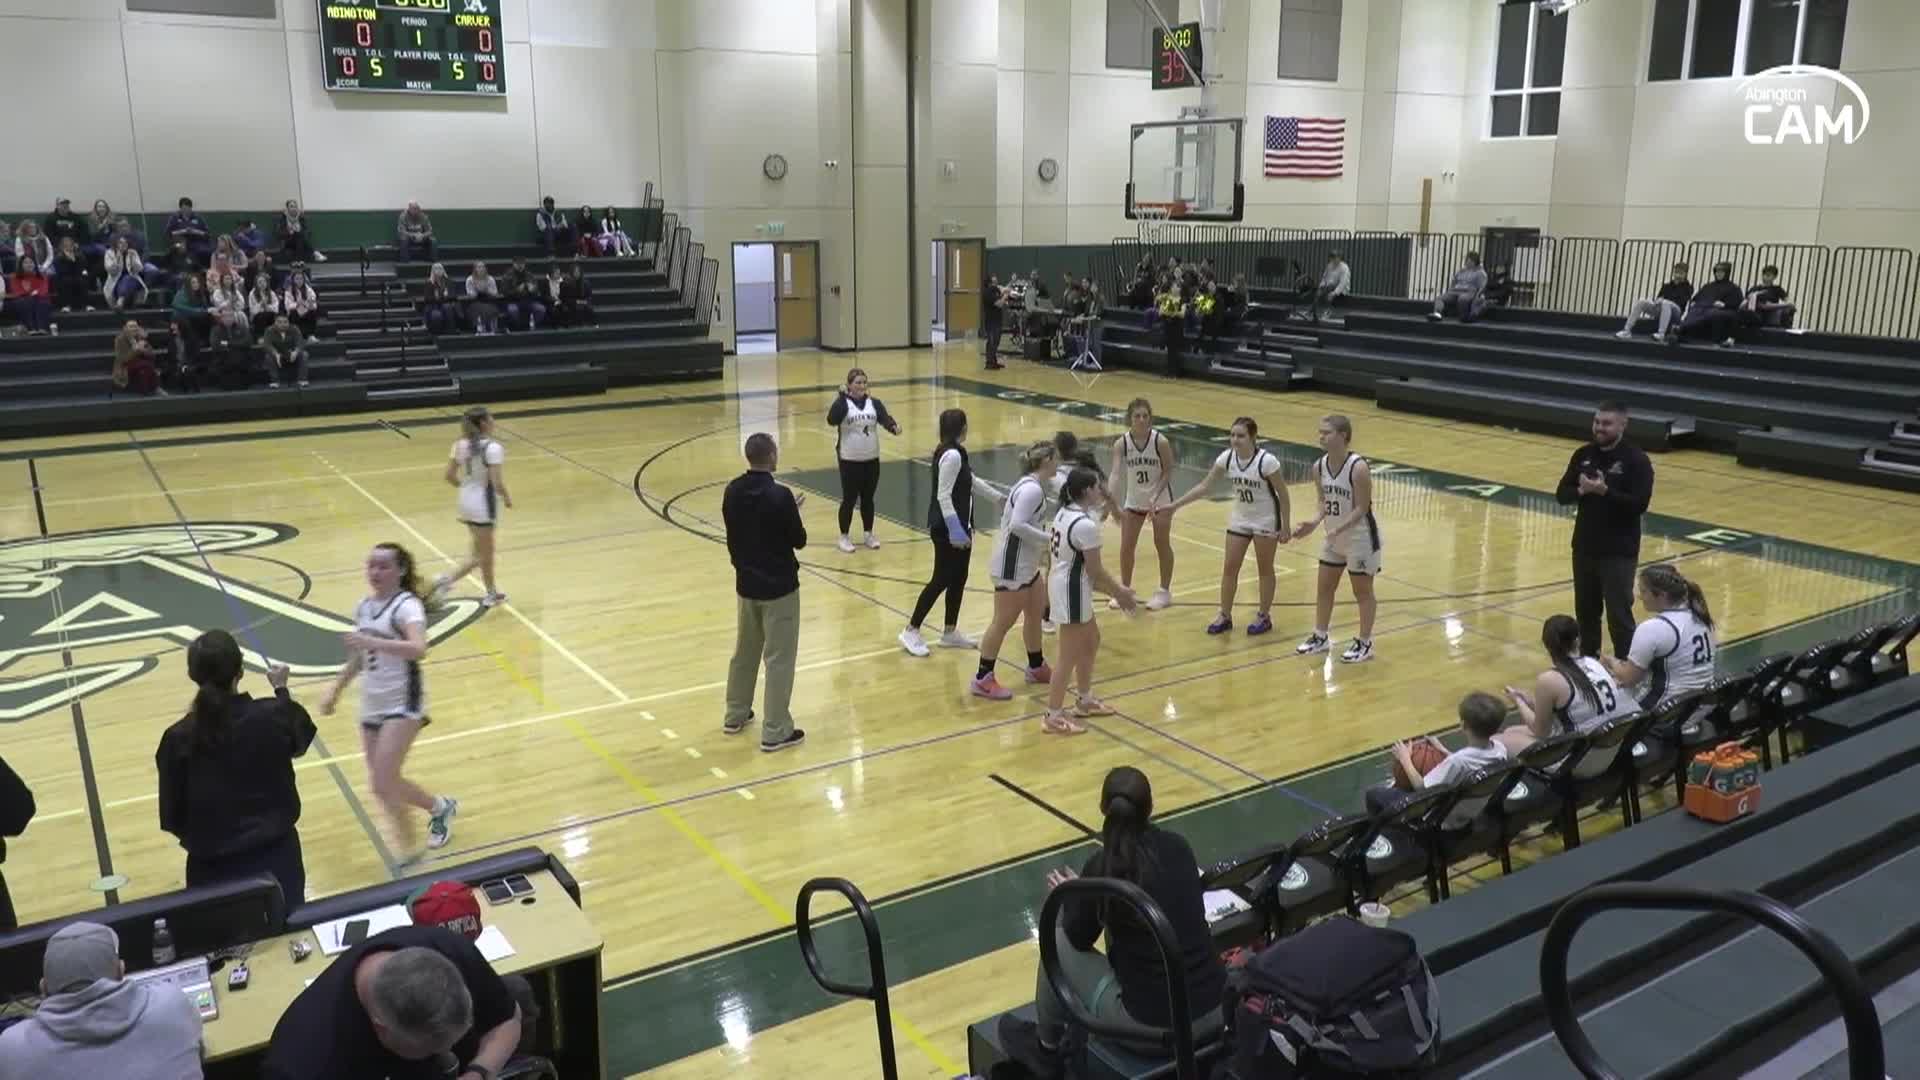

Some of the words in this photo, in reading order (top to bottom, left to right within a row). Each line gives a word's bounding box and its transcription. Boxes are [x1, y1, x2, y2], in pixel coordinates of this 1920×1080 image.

[327, 6, 376, 20] ABINGTON
[401, 17, 427, 26] PERIOD
[455, 14, 490, 27] CARVER
[357, 22, 370, 46] 0
[416, 29, 421, 46] 1
[479, 30, 491, 52] 0
[332, 48, 357, 56] FOULS
[394, 50, 421, 59] PLAYER
[423, 51, 441, 60] FOUL
[474, 54, 496, 62] FOULS
[343, 57, 354, 75] 0
[370, 58, 382, 76] 5
[452, 61, 464, 80] 5
[483, 63, 493, 80] 0
[336, 79, 359, 87] SCORE
[406, 81, 431, 89] MATCH
[476, 84, 498, 92] SCORE
[1136, 471, 1149, 484] 31
[1326, 501, 1340, 516] 33
[1692, 631, 1712, 665] 21
